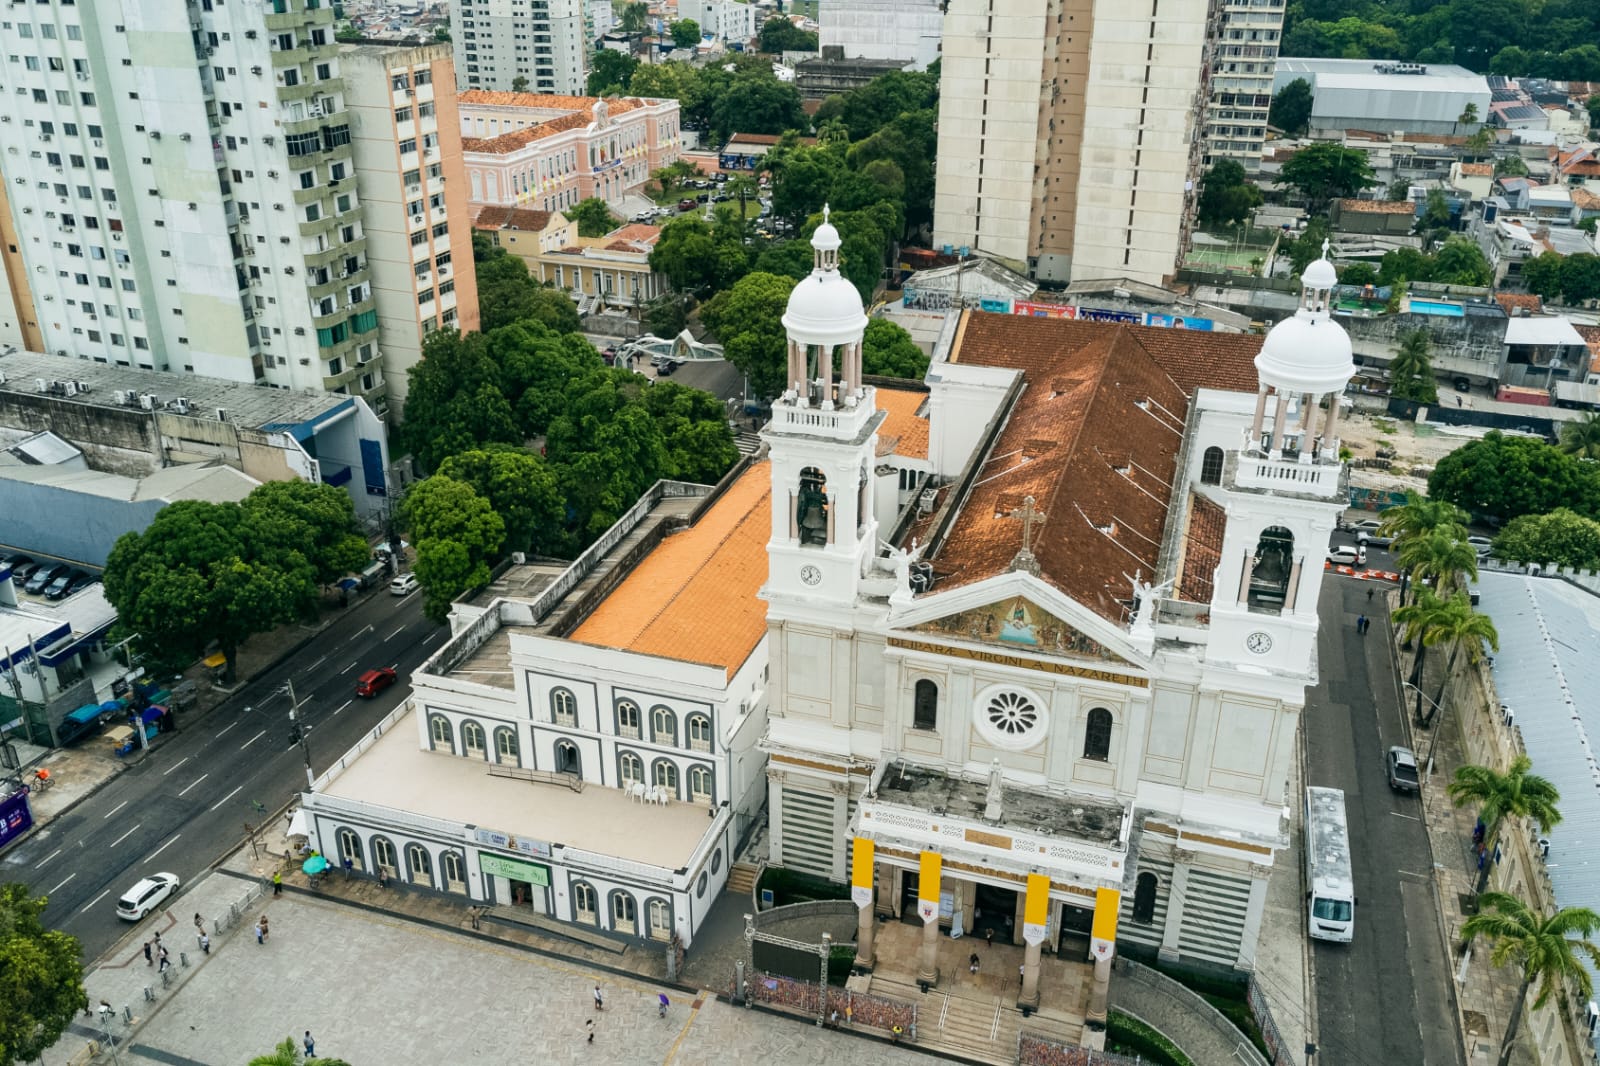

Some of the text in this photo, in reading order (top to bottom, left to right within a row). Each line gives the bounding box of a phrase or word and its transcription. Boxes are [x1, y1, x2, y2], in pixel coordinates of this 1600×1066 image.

[967, 650, 1022, 667] VIRGINI
[1031, 662, 1044, 671] A
[1054, 664, 1144, 687] NAZARETH
